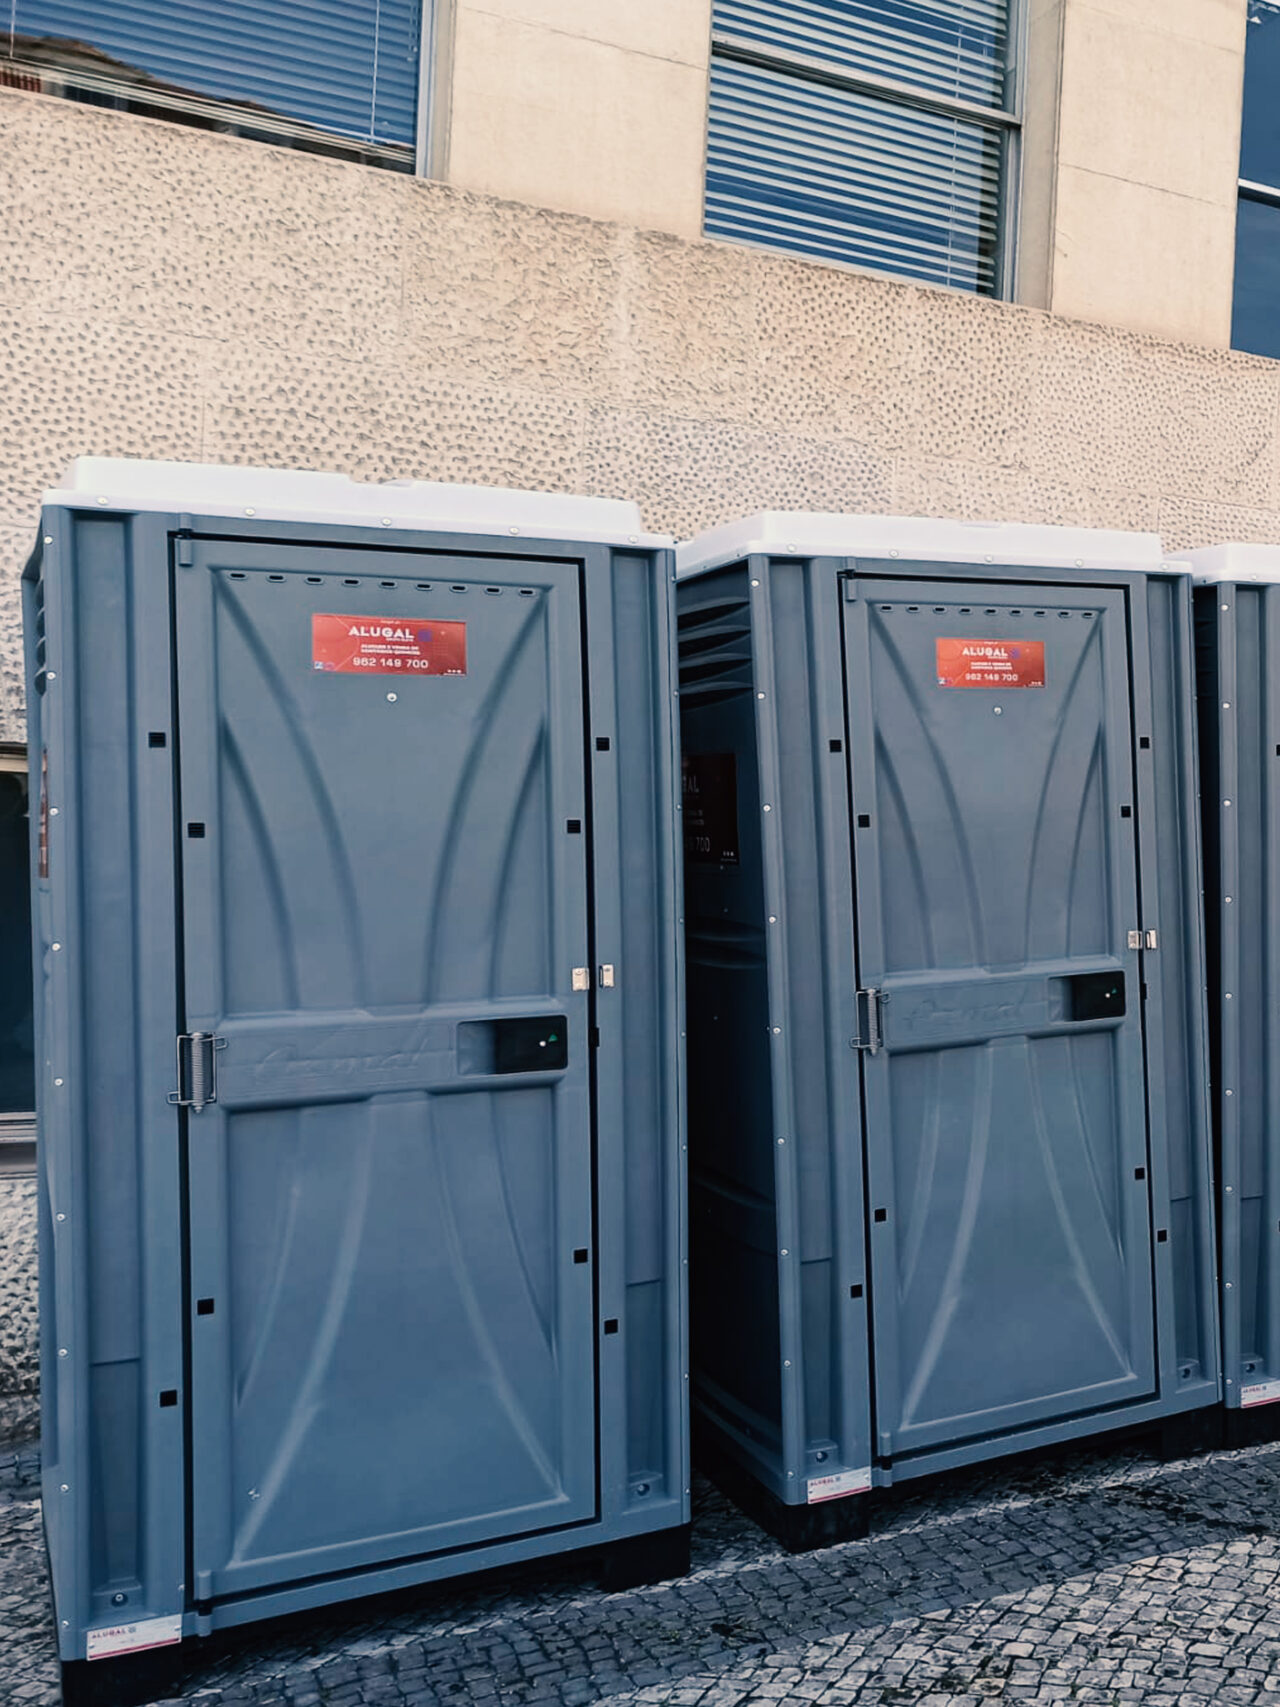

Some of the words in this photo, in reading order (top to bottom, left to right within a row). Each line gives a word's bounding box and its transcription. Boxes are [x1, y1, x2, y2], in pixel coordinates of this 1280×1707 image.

[348, 626, 414, 638] ALUGAL
[962, 647, 1008, 656] ALUGAL
[381, 658, 402, 668] 149
[406, 659, 429, 669] 700
[1001, 674, 1018, 682] 700
[92, 1629, 126, 1639] ALUGAL
